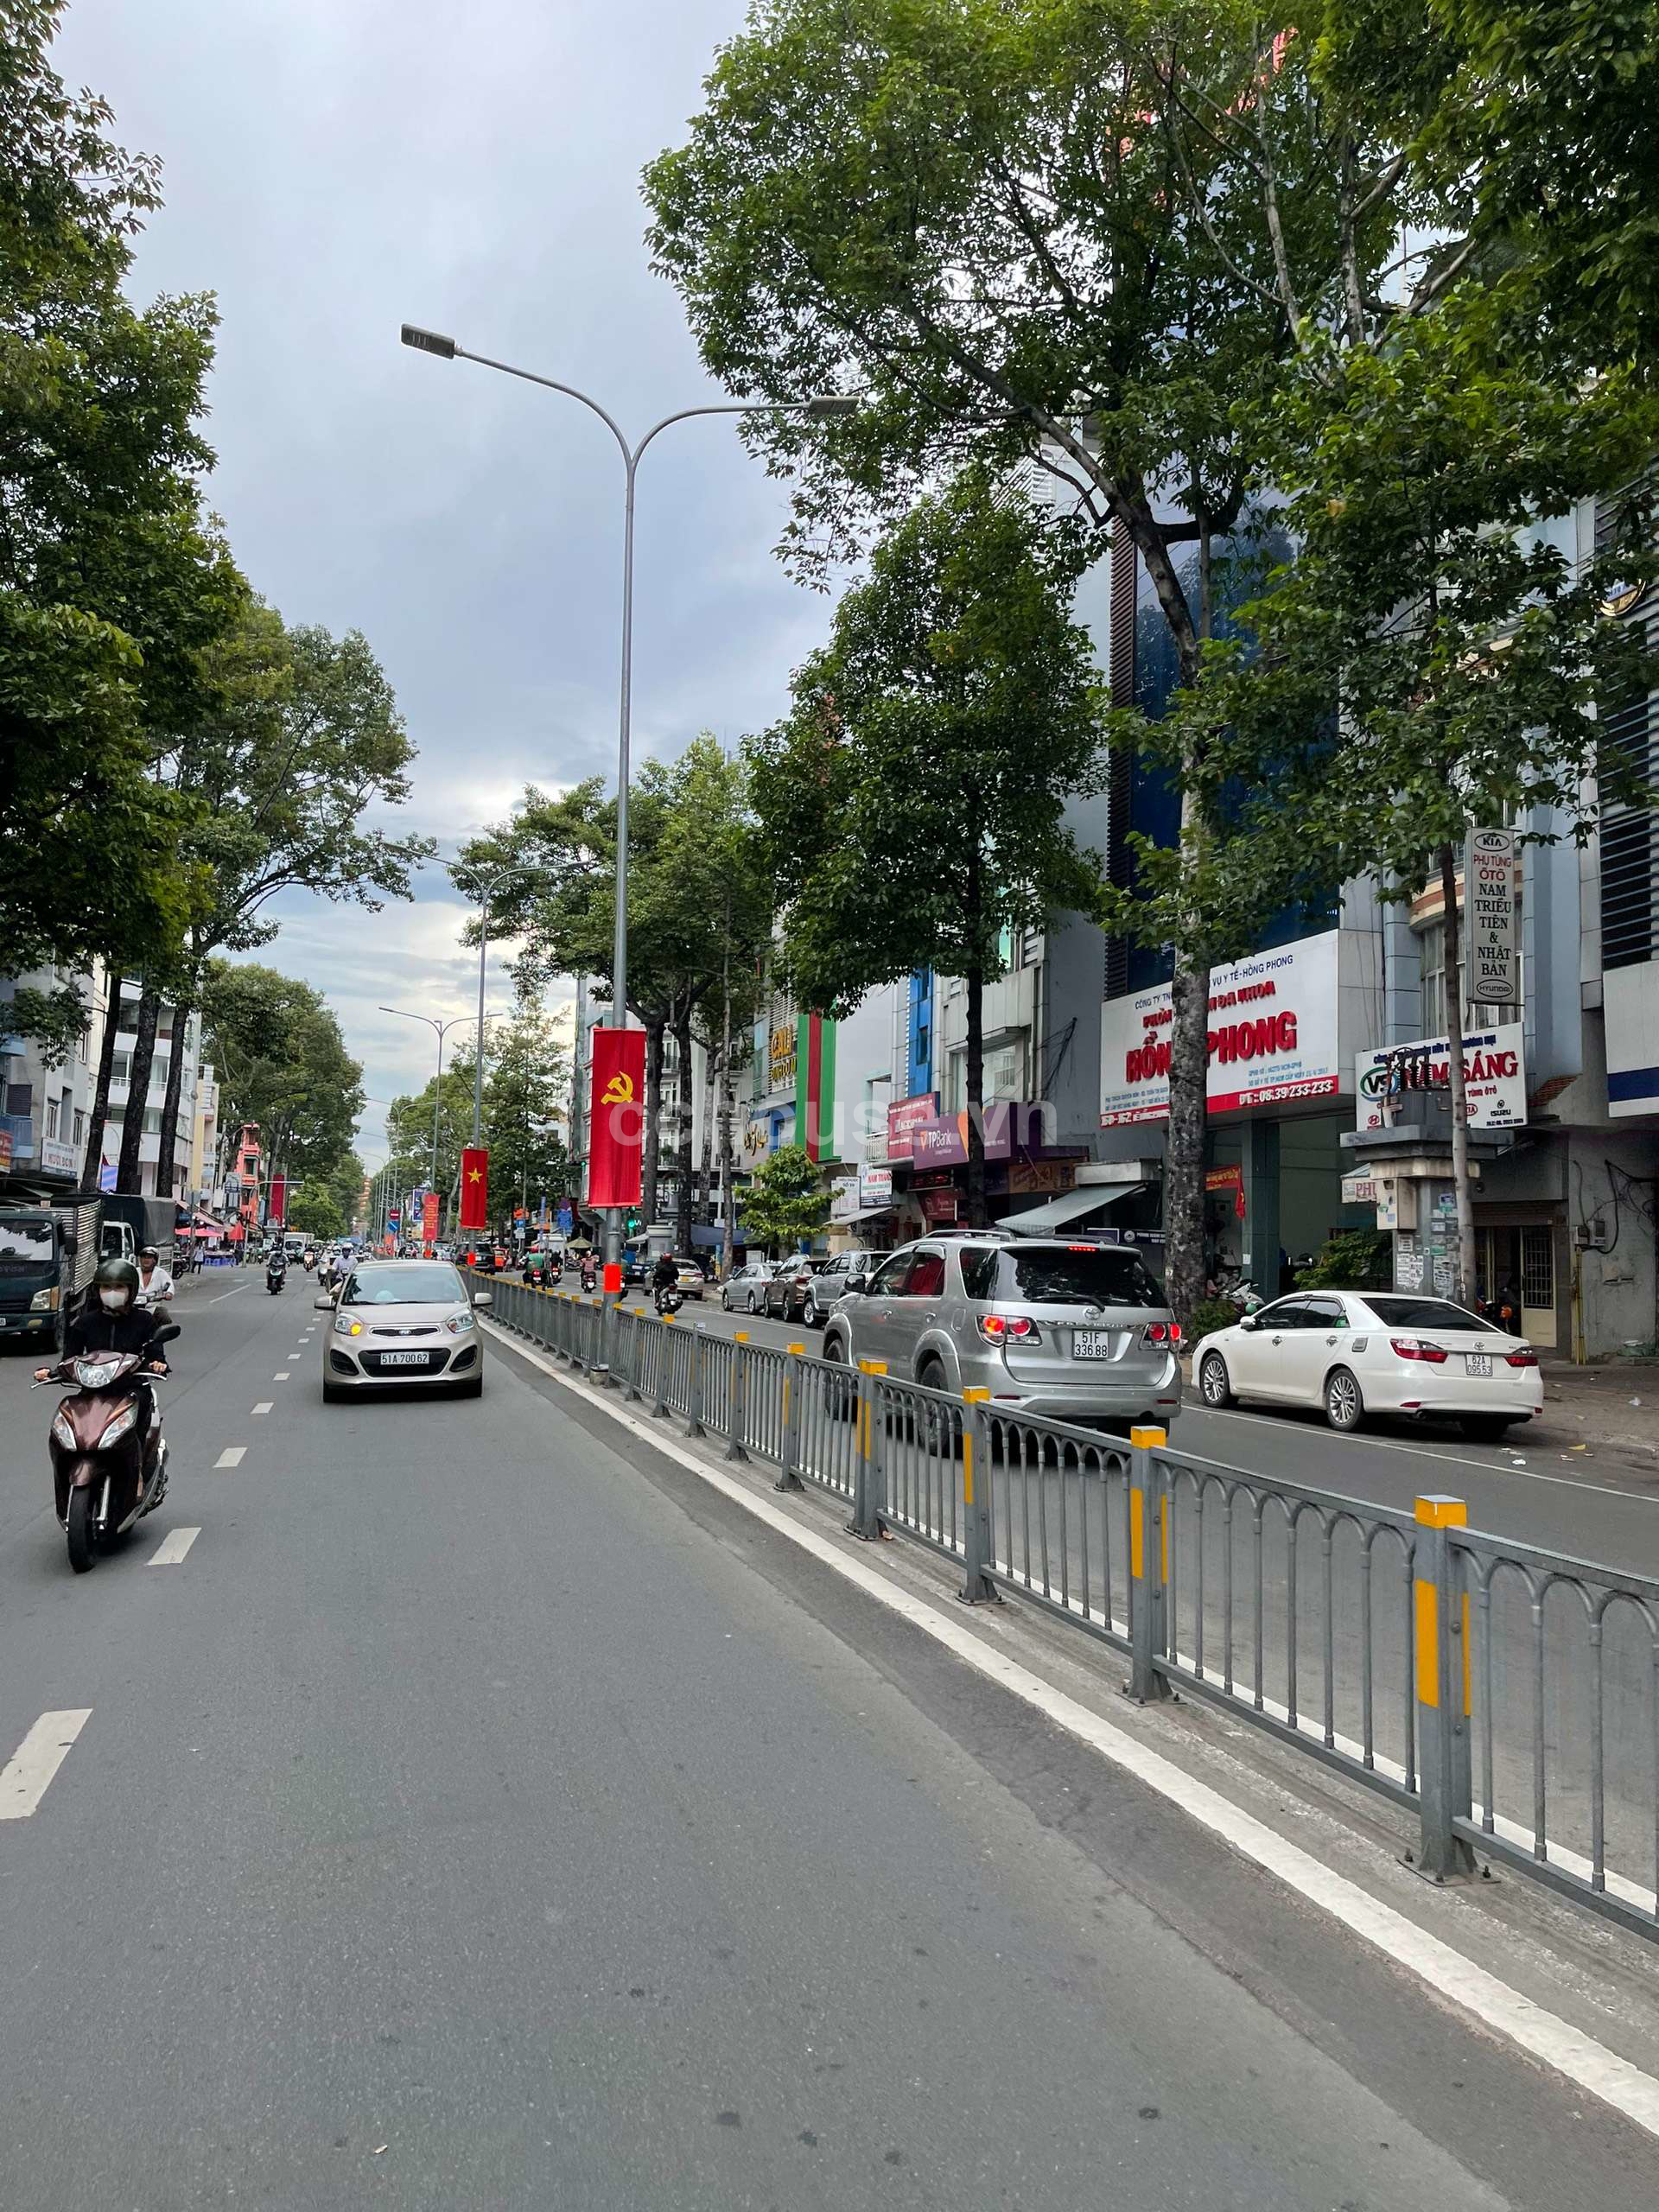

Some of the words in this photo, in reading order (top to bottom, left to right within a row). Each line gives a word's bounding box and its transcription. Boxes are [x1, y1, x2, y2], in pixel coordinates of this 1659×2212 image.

[1483, 837, 1502, 847] KIA
[1479, 884, 1507, 897] NAM
[1479, 915, 1509, 929] TIÊN
[1490, 932, 1498, 944] &
[1266, 955, 1294, 971] PHONG
[1205, 1011, 1297, 1068] PHONG
[1126, 1031, 1172, 1083] HỒN
[928, 1128, 952, 1148] TPBank
[1082, 1332, 1100, 1344] 51F
[382, 1354, 397, 1363] 51A
